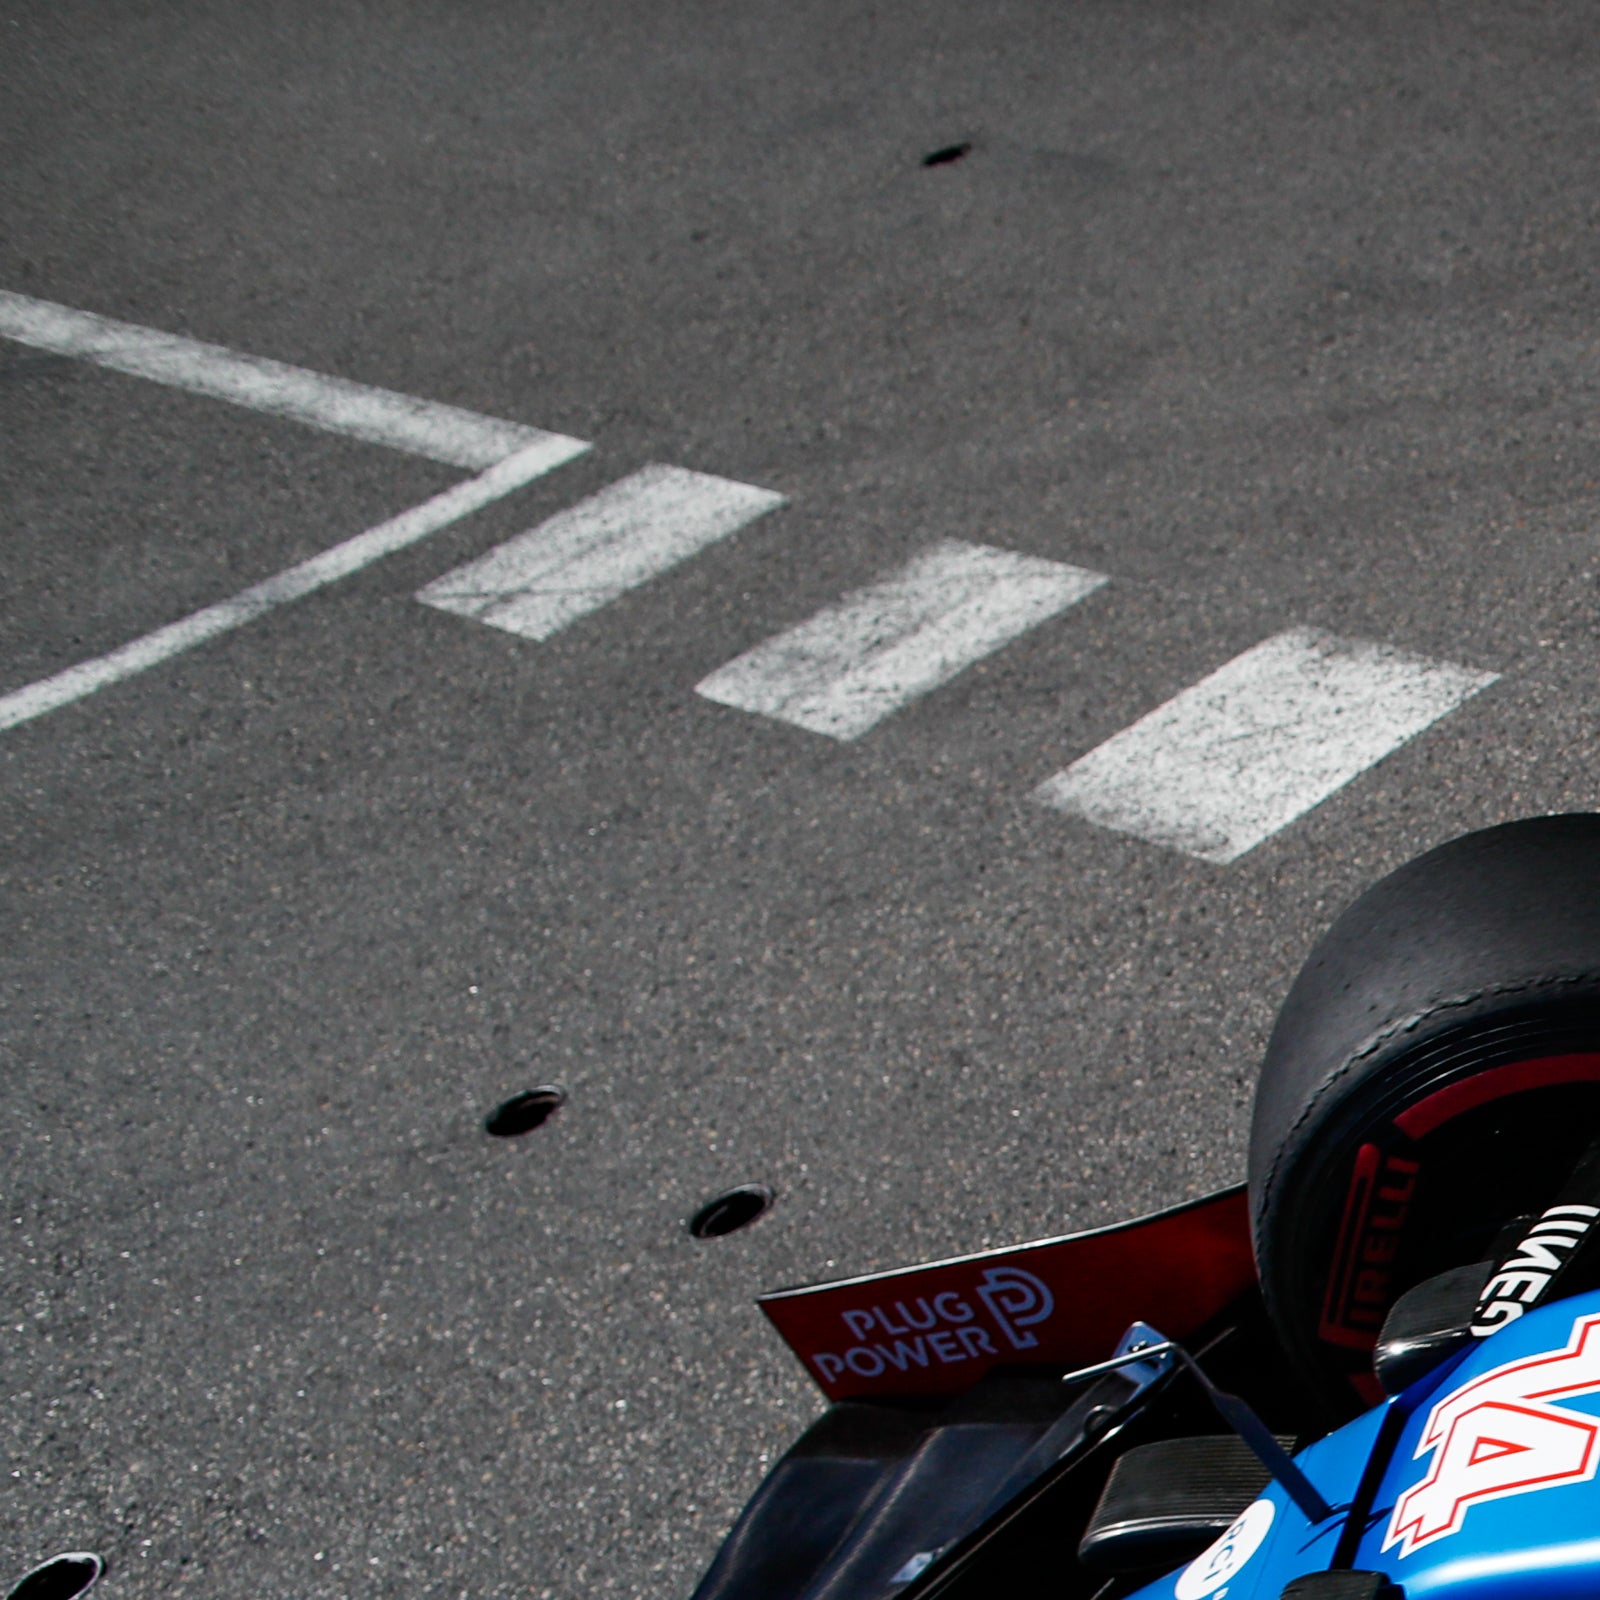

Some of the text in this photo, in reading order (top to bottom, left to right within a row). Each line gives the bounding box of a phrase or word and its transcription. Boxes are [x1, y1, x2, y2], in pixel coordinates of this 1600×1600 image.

[1319, 1142, 1420, 1350] PIRELLI
[841, 1292, 975, 1341] PLUG
[812, 1325, 999, 1384] POWER
[1203, 1518, 1247, 1582] RCi
